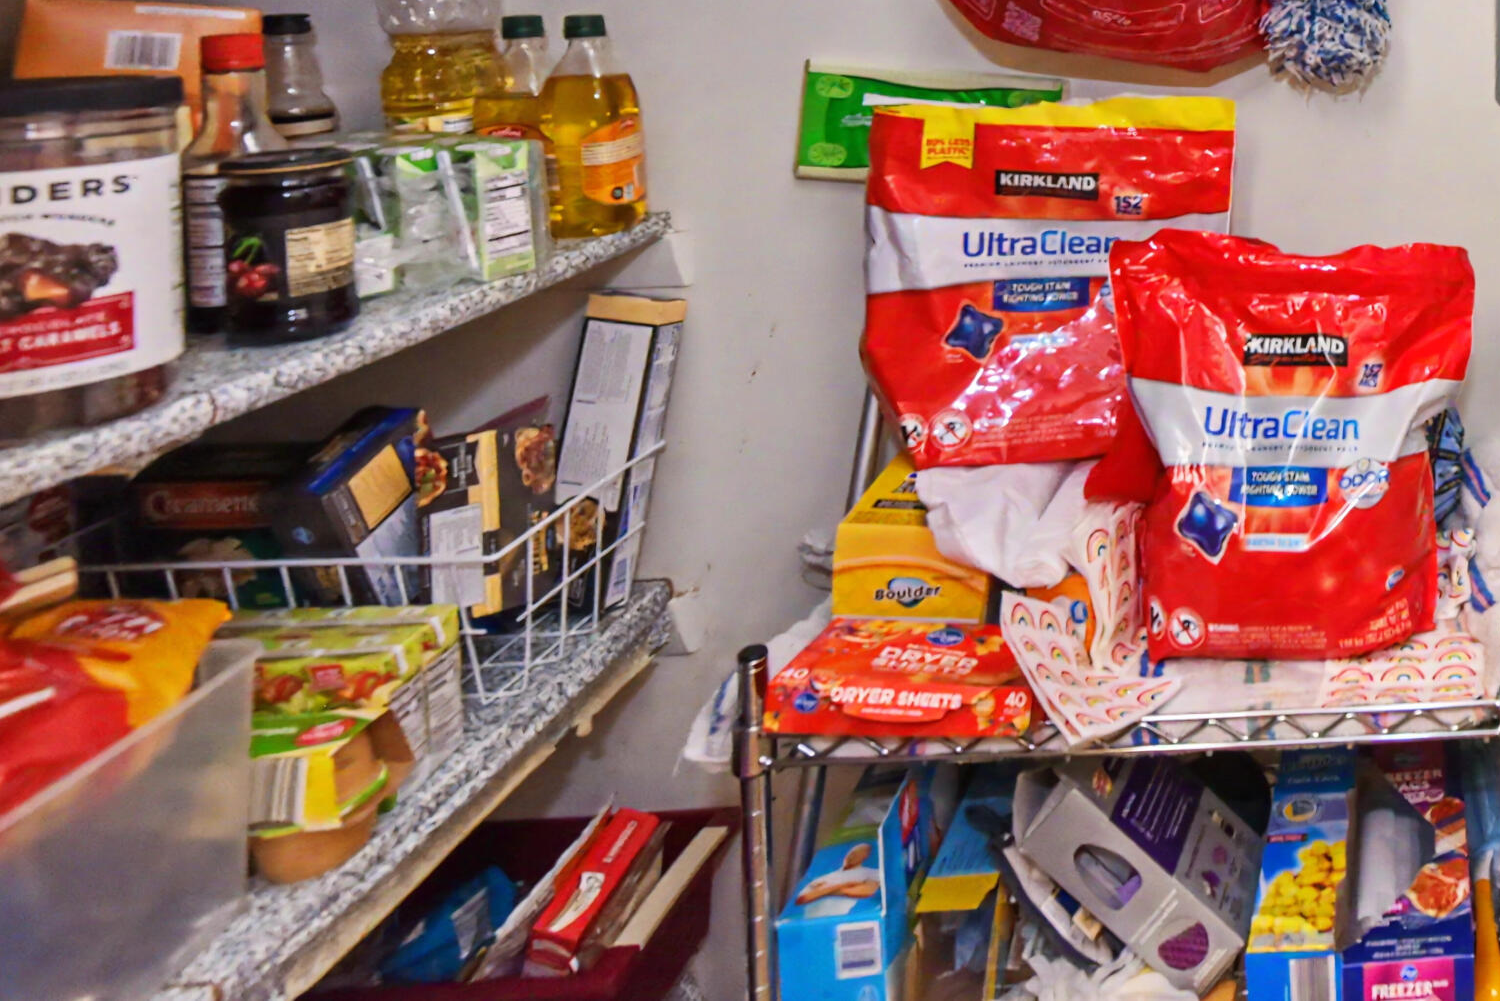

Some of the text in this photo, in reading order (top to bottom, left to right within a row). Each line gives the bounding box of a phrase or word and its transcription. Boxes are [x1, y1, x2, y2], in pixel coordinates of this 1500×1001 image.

[0, 175, 131, 205] DERS
[1000, 172, 1096, 191] KIRKLAND
[1249, 336, 1345, 354] KIRKLAND
[1204, 406, 1360, 440] UltraClean
[1339, 469, 1391, 489] ODOR
[874, 585, 941, 601] Boulder
[830, 686, 895, 705] DRYER
[896, 689, 963, 709] SHEETS
[1004, 691, 1028, 707] 40
[1371, 980, 1433, 1000] FREEZER
